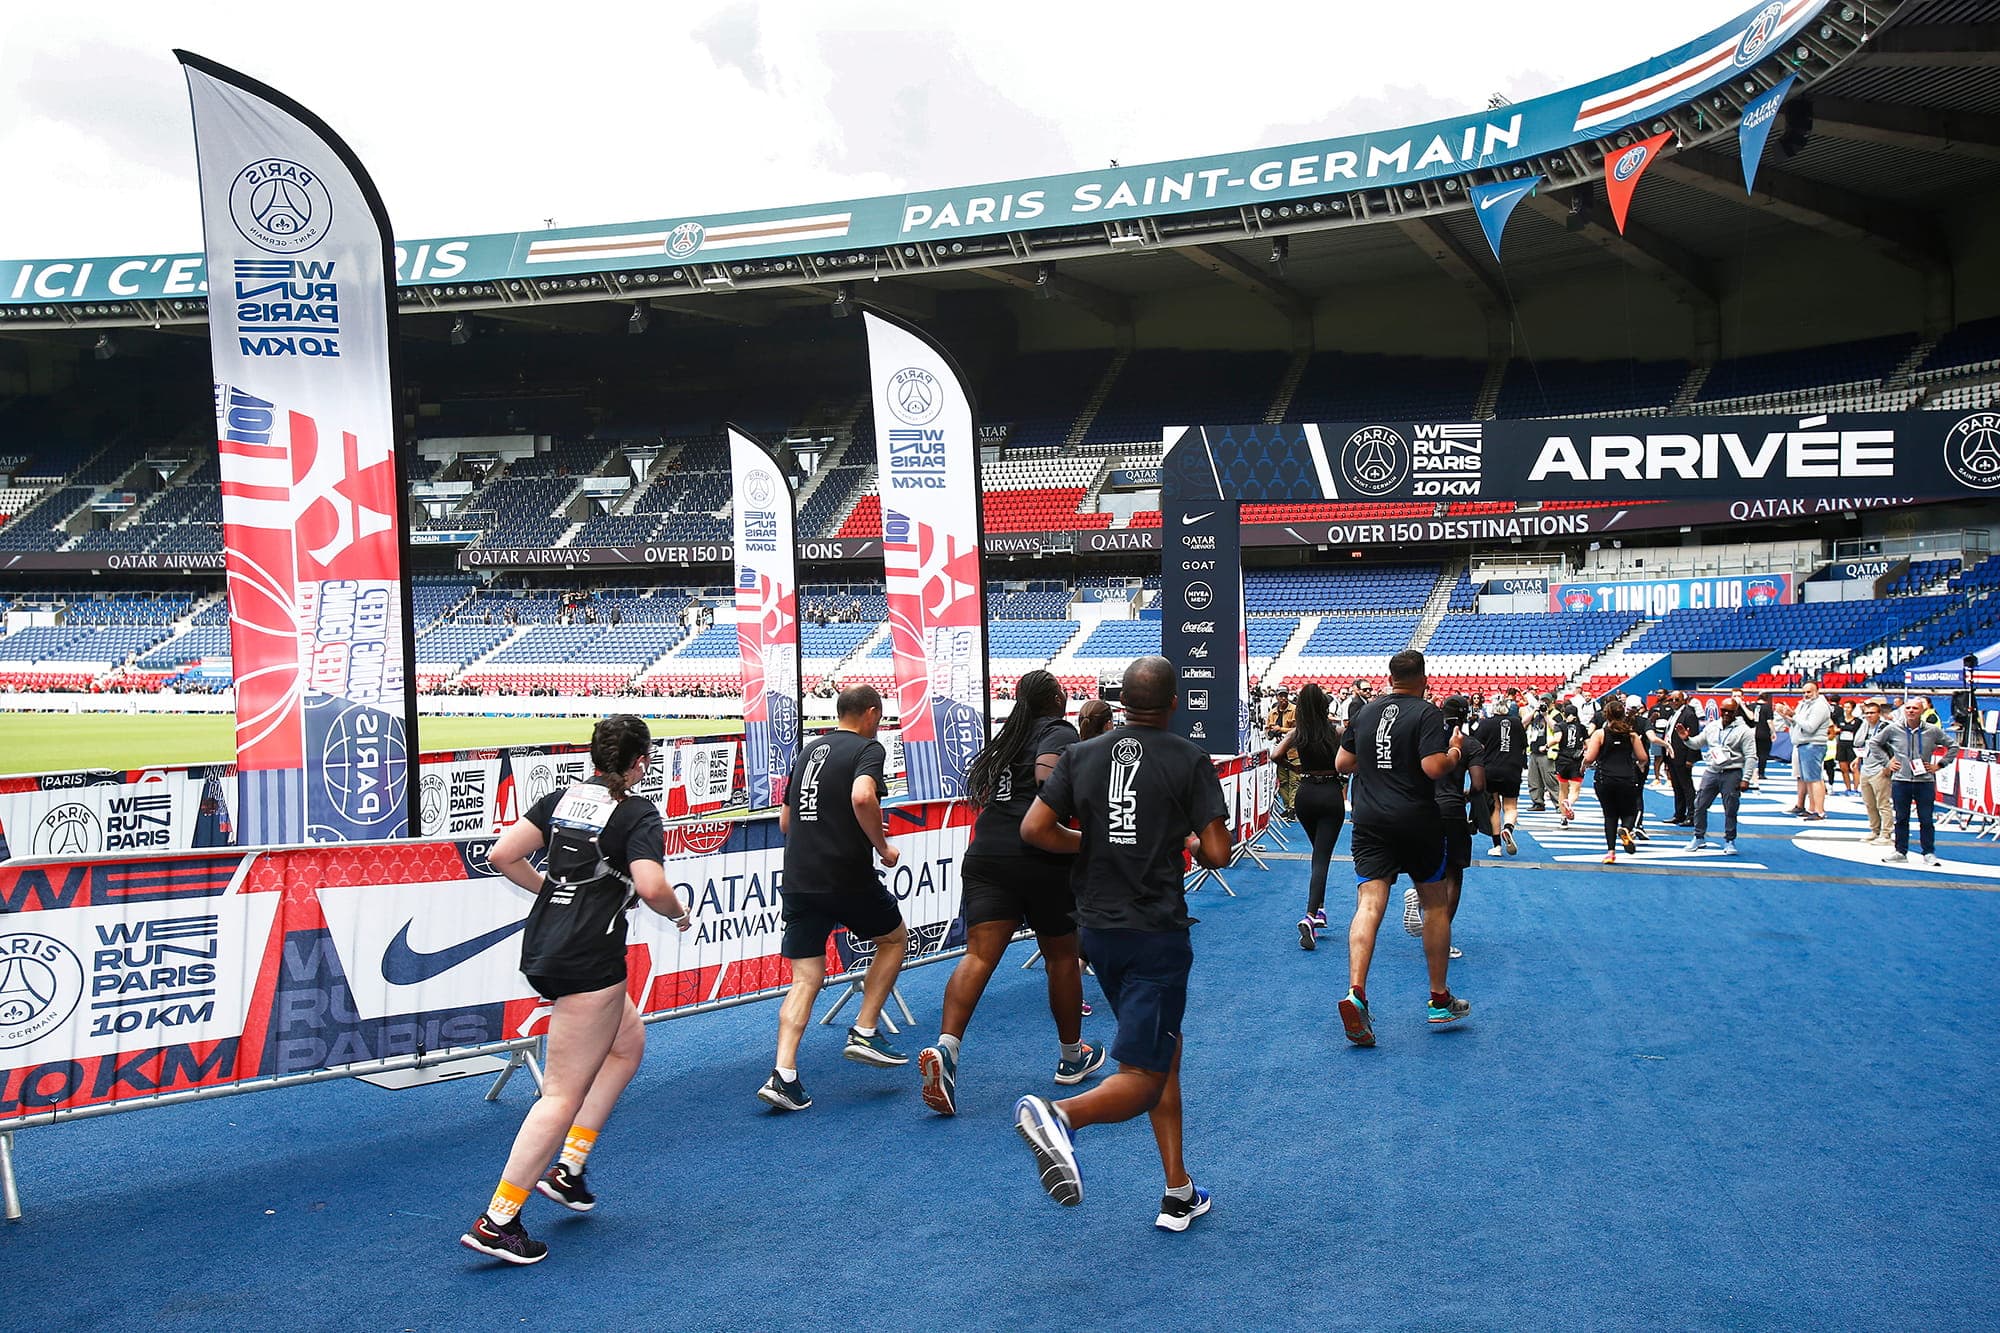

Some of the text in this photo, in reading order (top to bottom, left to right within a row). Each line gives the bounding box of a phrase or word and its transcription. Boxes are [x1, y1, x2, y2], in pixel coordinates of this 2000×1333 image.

[902, 115, 1522, 233] PARIS SAINT-GERMAIN
[10, 263, 94, 299] ICI
[108, 258, 209, 297] C'E
[1353, 429, 1398, 447] PARIS
[1413, 423, 1482, 439] WE
[1413, 439, 1482, 455] RUN
[1527, 414, 1895, 481] ARRIVÉE
[1413, 455, 1482, 471] PARIS
[1125, 469, 1158, 481] QATAR
[1729, 498, 1806, 521] QATAR
[1327, 514, 1589, 544] OVER 150 DESTINATIONS
[1091, 533, 1153, 551] QATAR
[1182, 536, 1215, 547] QATAR
[108, 555, 227, 569] QATAR AIRWAYS
[469, 549, 591, 564] QATAR AIRWAYS
[644, 547, 689, 562] OVER
[693, 546, 717, 562] 150
[1182, 561, 1216, 570] GOAT
[1847, 562, 1889, 578] QATAR
[1504, 579, 1542, 592] QATAR
[1094, 589, 1128, 600] QATAR
[710, 749, 729, 759] WE
[556, 762, 585, 774] WE
[710, 759, 728, 769] RUN
[45, 775, 83, 787] PARIS
[451, 770, 485, 783] WE
[709, 769, 728, 779] PARIS
[451, 783, 484, 797] RUN
[1109, 760, 1125, 830] WE
[1123, 760, 1141, 830] RUN
[108, 794, 171, 814] WE
[450, 797, 484, 811] PARIS
[46, 806, 90, 828] PARIS
[107, 812, 171, 833] RUN
[687, 821, 726, 835] PARIS
[107, 829, 170, 850] PARIS
[1109, 836, 1137, 845] PARIS
[95, 914, 218, 946] WE
[93, 938, 218, 972] RUN
[92, 963, 216, 997] PARIS
[90, 1001, 215, 1037] 10KM
[276, 1014, 489, 1076] PARIS
